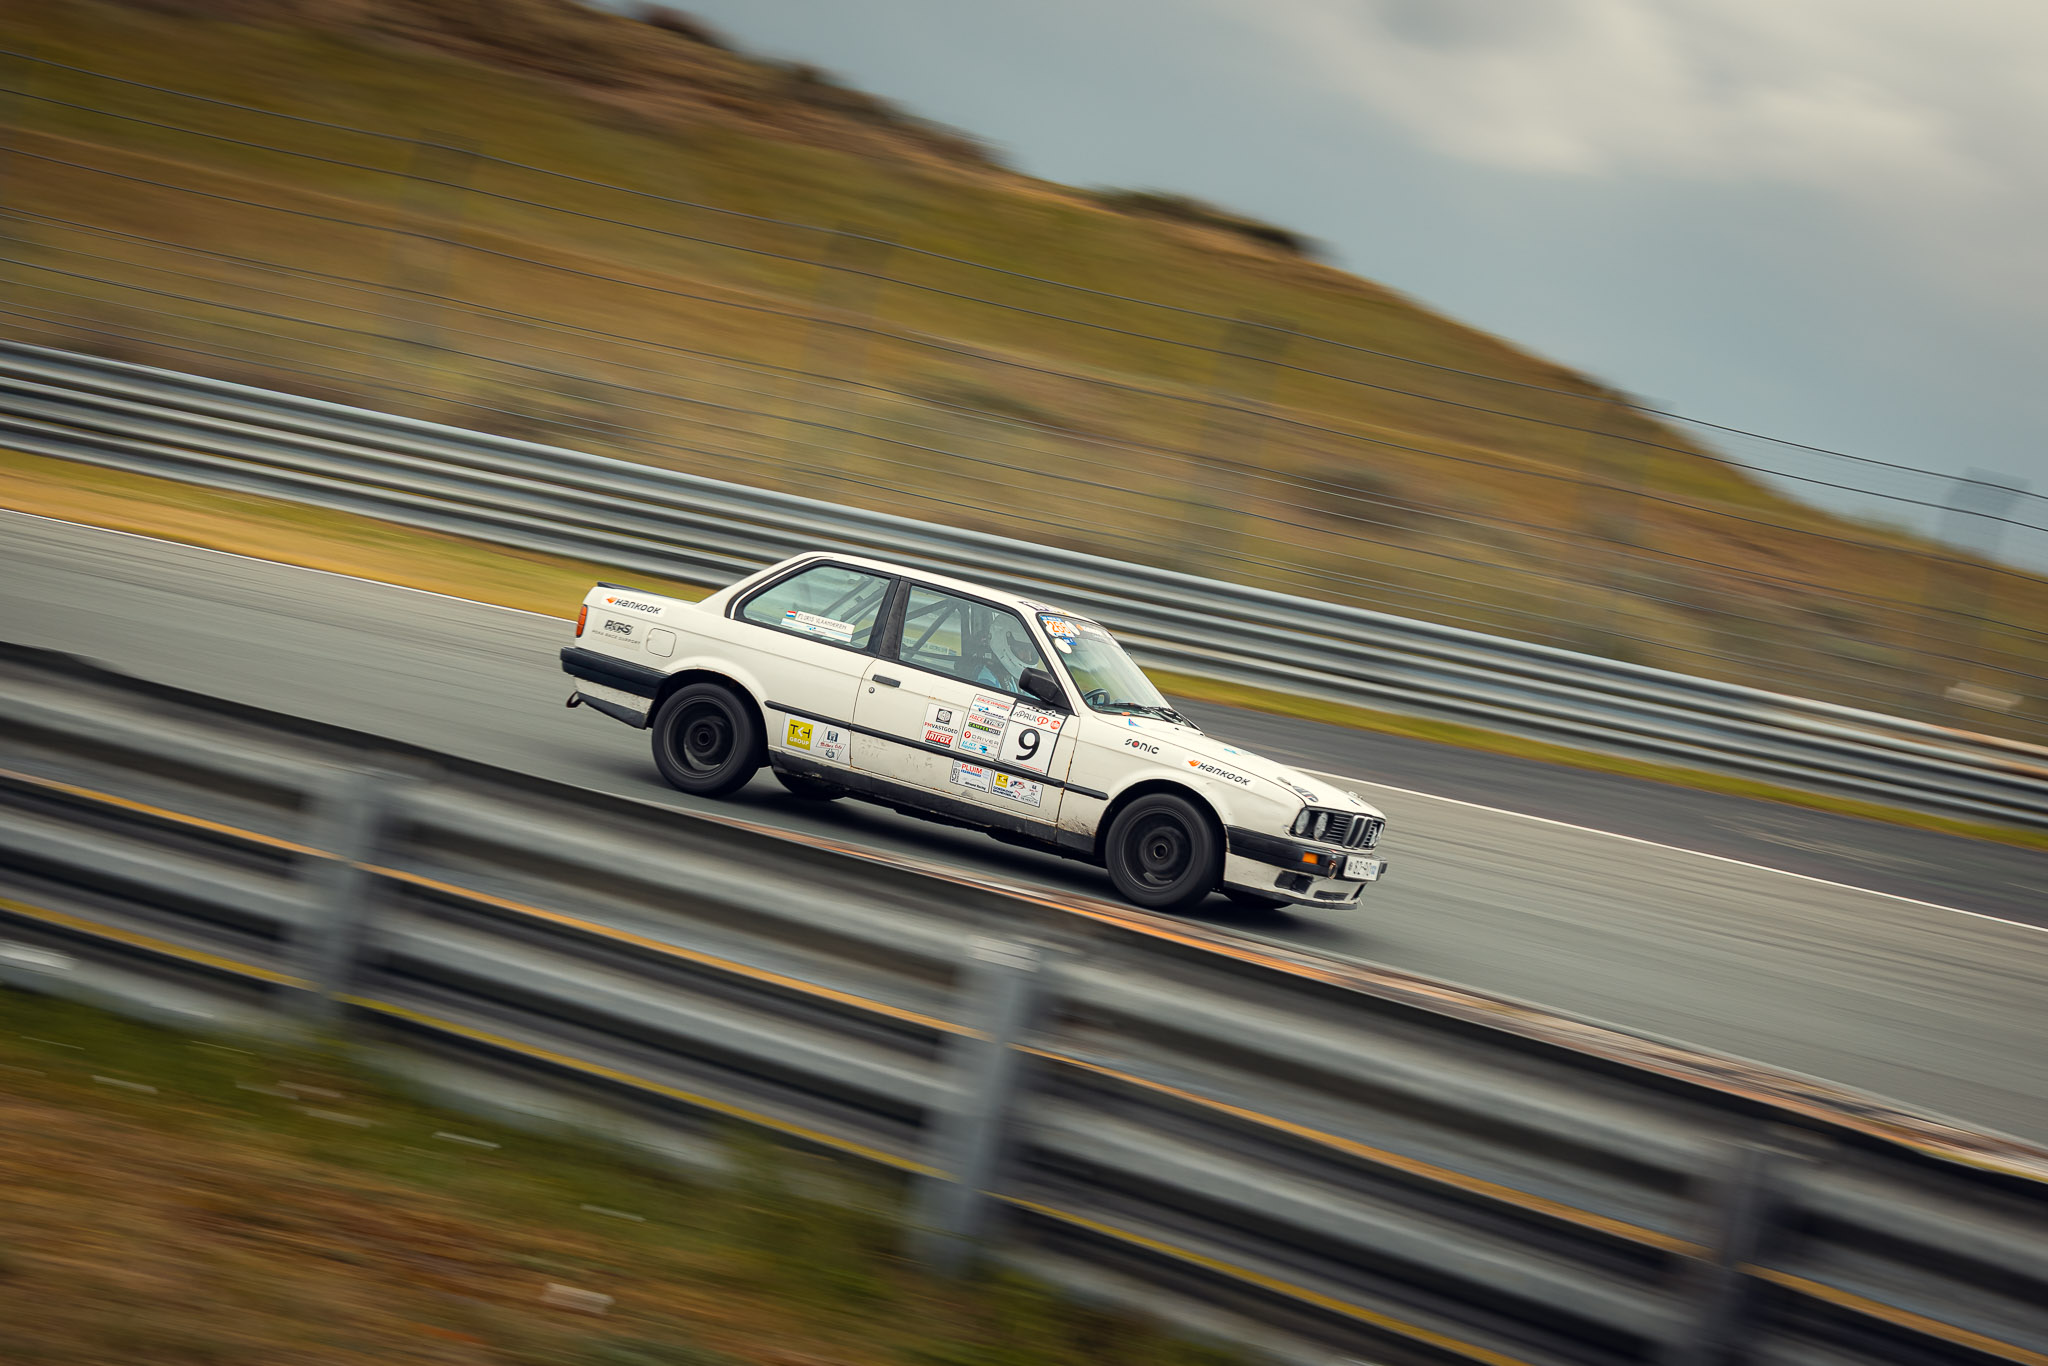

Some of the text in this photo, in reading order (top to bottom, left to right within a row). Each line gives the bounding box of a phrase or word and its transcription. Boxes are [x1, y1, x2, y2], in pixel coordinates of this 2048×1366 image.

[789, 736, 810, 746] GROUP
[972, 736, 1000, 746] DRIVER
[1016, 728, 1041, 760] 9
[961, 764, 982, 774] PLUIM
